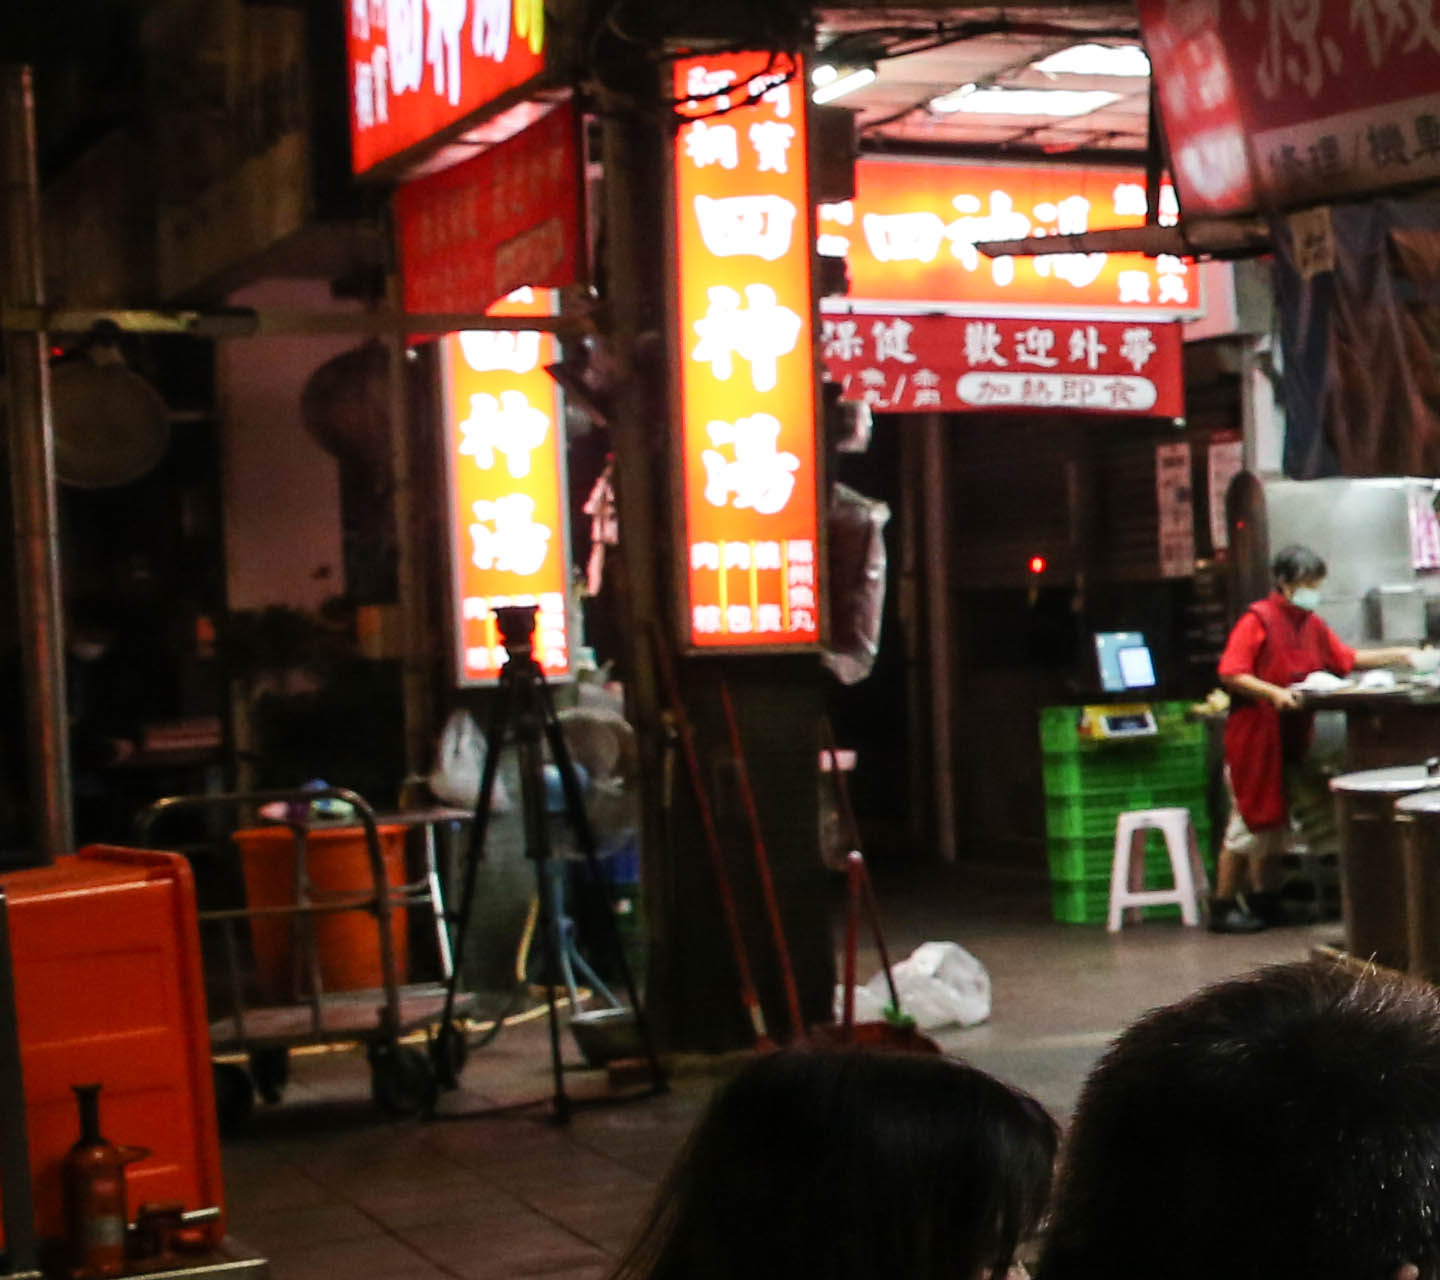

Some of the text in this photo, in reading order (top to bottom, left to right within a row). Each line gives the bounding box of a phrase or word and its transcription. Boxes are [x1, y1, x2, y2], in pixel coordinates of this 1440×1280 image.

[691, 194, 800, 514] 四神湯
[963, 321, 1157, 372] 歡迎外帶
